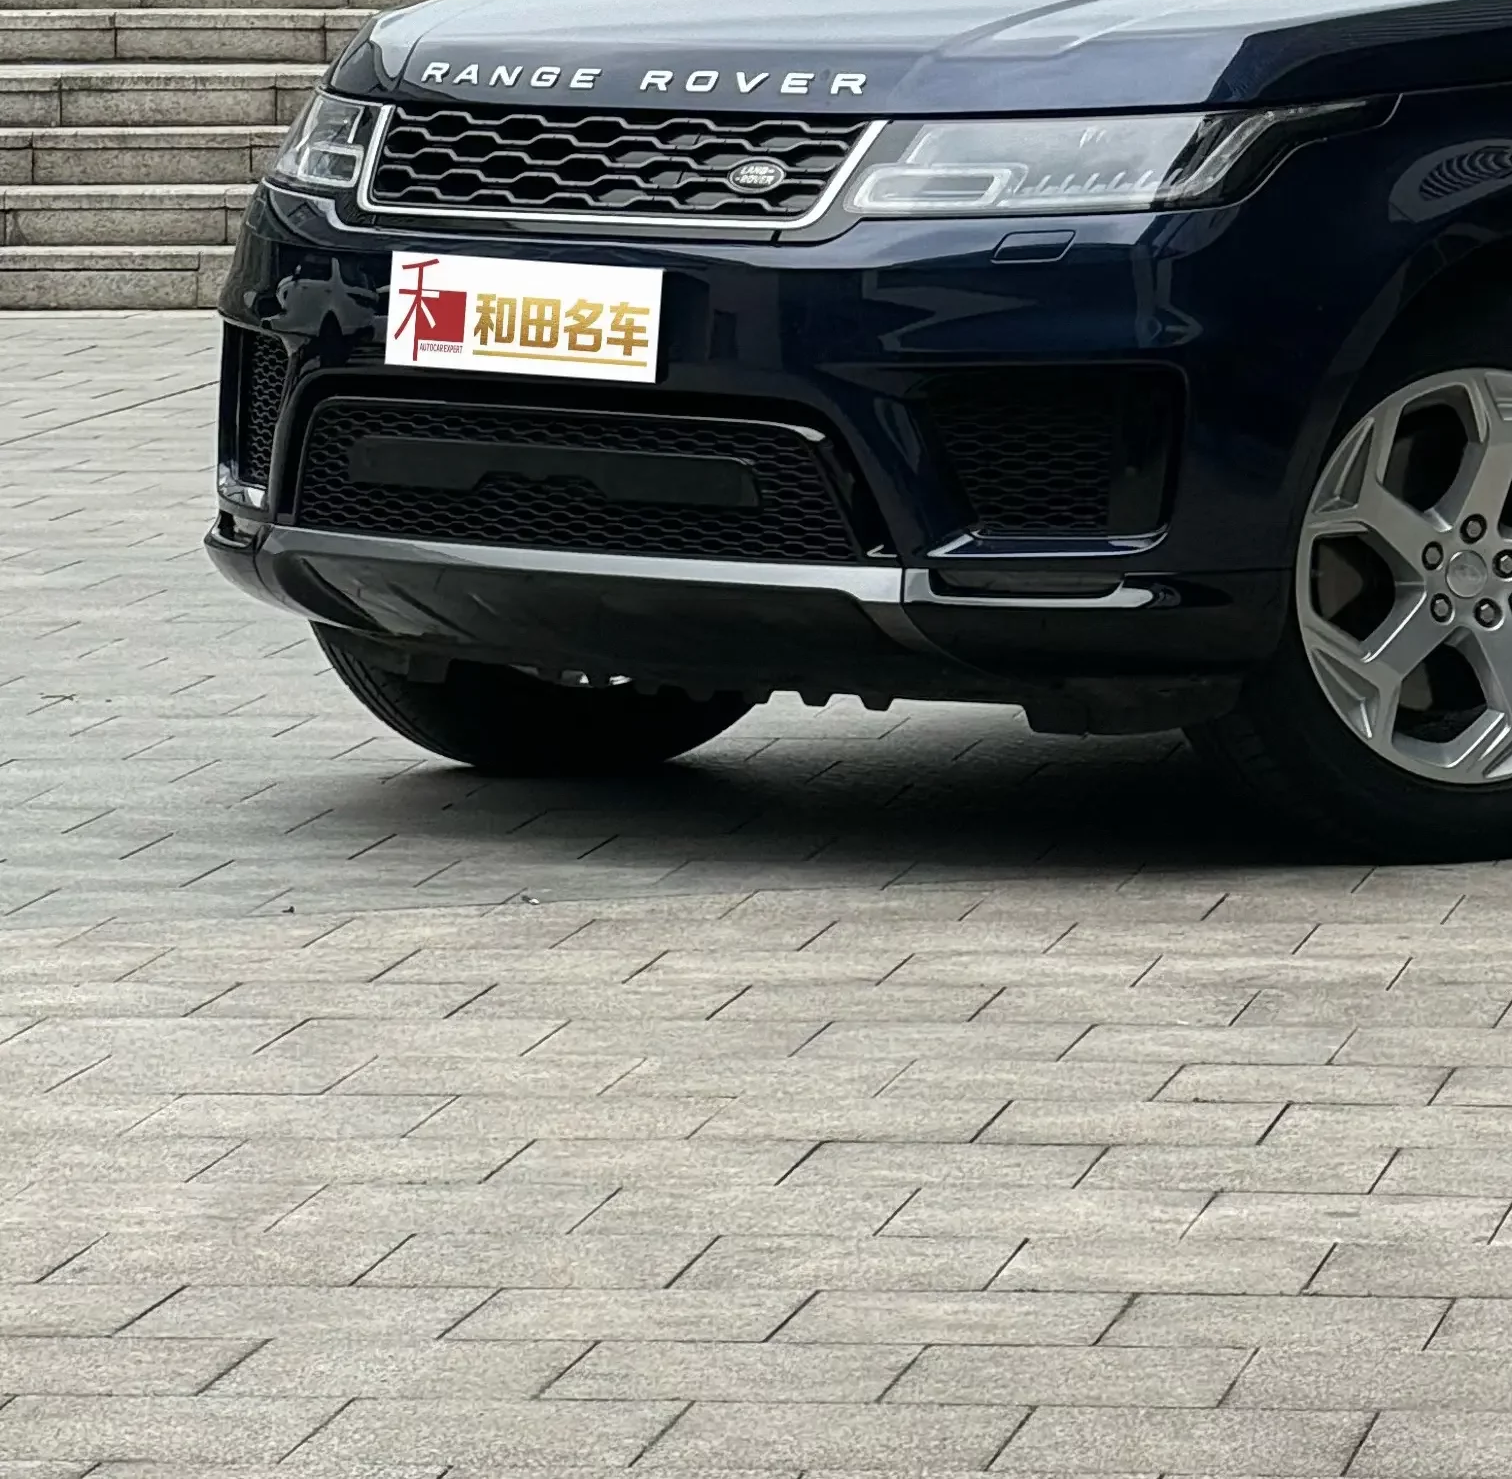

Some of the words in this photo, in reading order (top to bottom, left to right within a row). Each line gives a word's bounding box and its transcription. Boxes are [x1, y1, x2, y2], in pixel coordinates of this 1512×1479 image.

[420, 61, 602, 90] RANGE
[638, 69, 868, 96] ROVER
[472, 291, 651, 358] 和田名车
